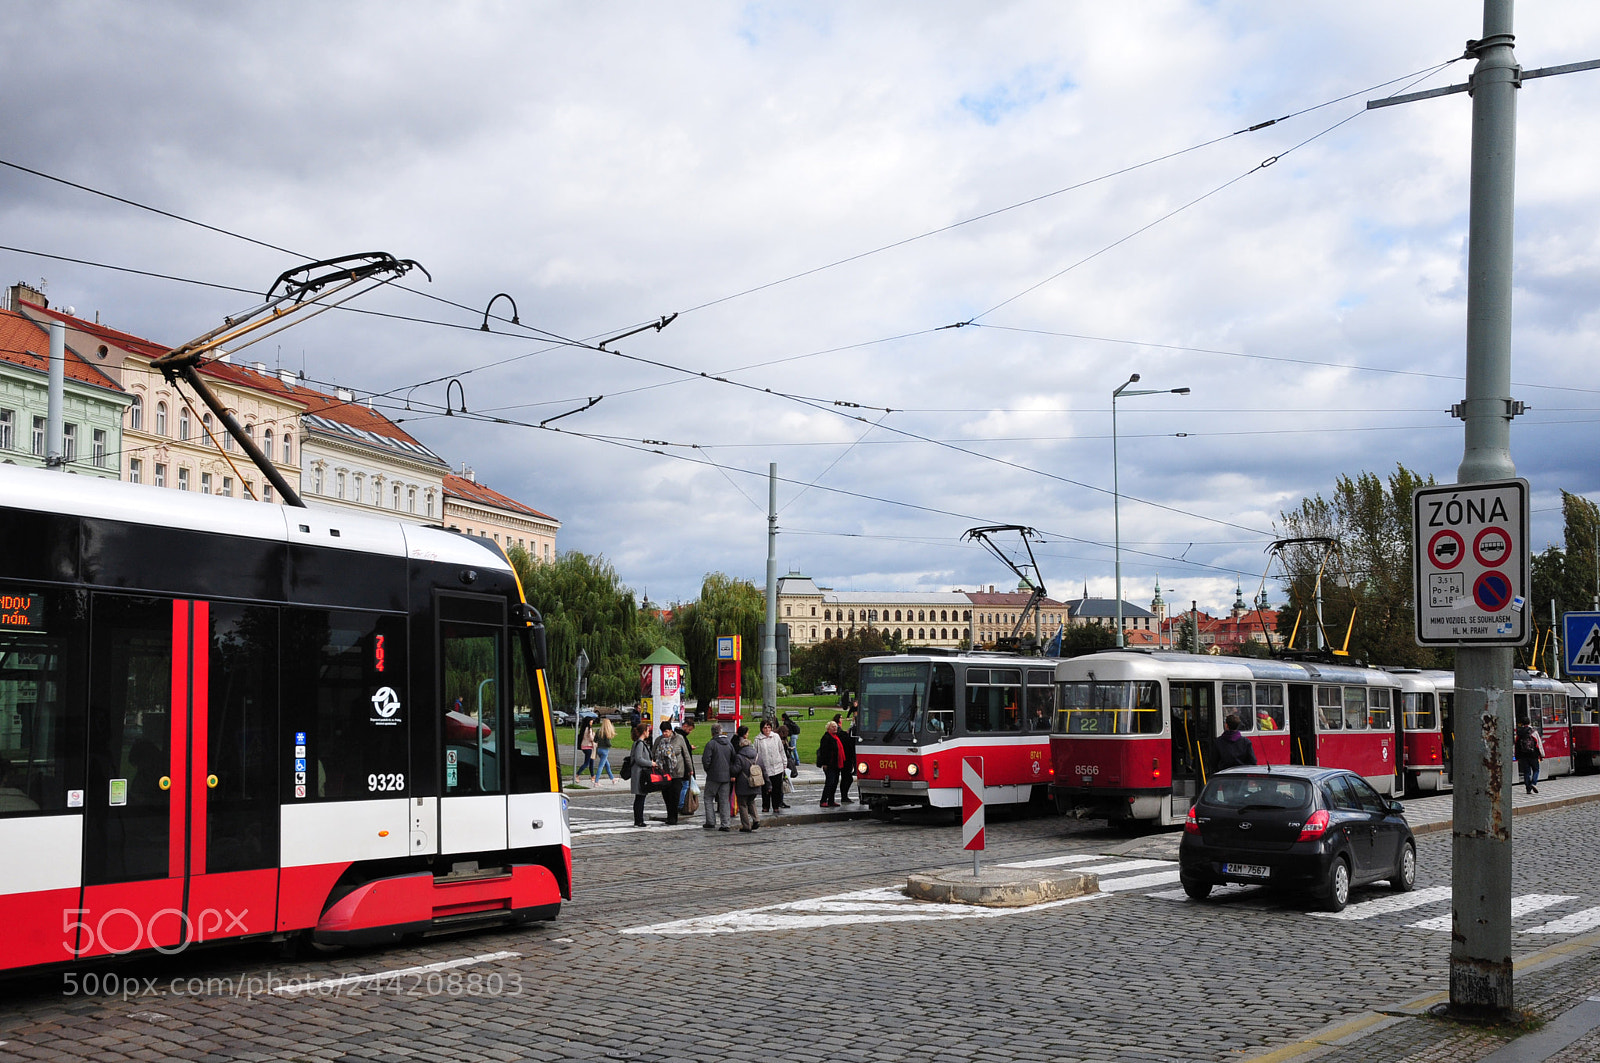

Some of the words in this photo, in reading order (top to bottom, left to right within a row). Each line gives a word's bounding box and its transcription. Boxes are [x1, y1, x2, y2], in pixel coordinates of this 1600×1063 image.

[1428, 494, 1509, 527] ZÓNA
[1438, 576, 1448, 585] 3,5
[1432, 586, 1442, 594] Po
[1450, 585, 1460, 594] Pá
[2, 610, 31, 625] nám.
[1430, 617, 1445, 625] MIMO
[1445, 616, 1467, 624] VOZIDEL
[1469, 616, 1477, 624] SE
[1477, 615, 1511, 624] SOUHLASEM
[1452, 627, 1461, 635] HL.
[1462, 627, 1469, 635] M.
[1470, 627, 1488, 635] PRAHY
[1080, 718, 1098, 731] 22
[1030, 751, 1042, 760] 8741
[879, 760, 897, 769] 8741
[1075, 765, 1099, 775] 8566
[367, 773, 405, 792] 9328
[1228, 864, 1243, 873] 2AM
[1247, 865, 1267, 875] 7567
